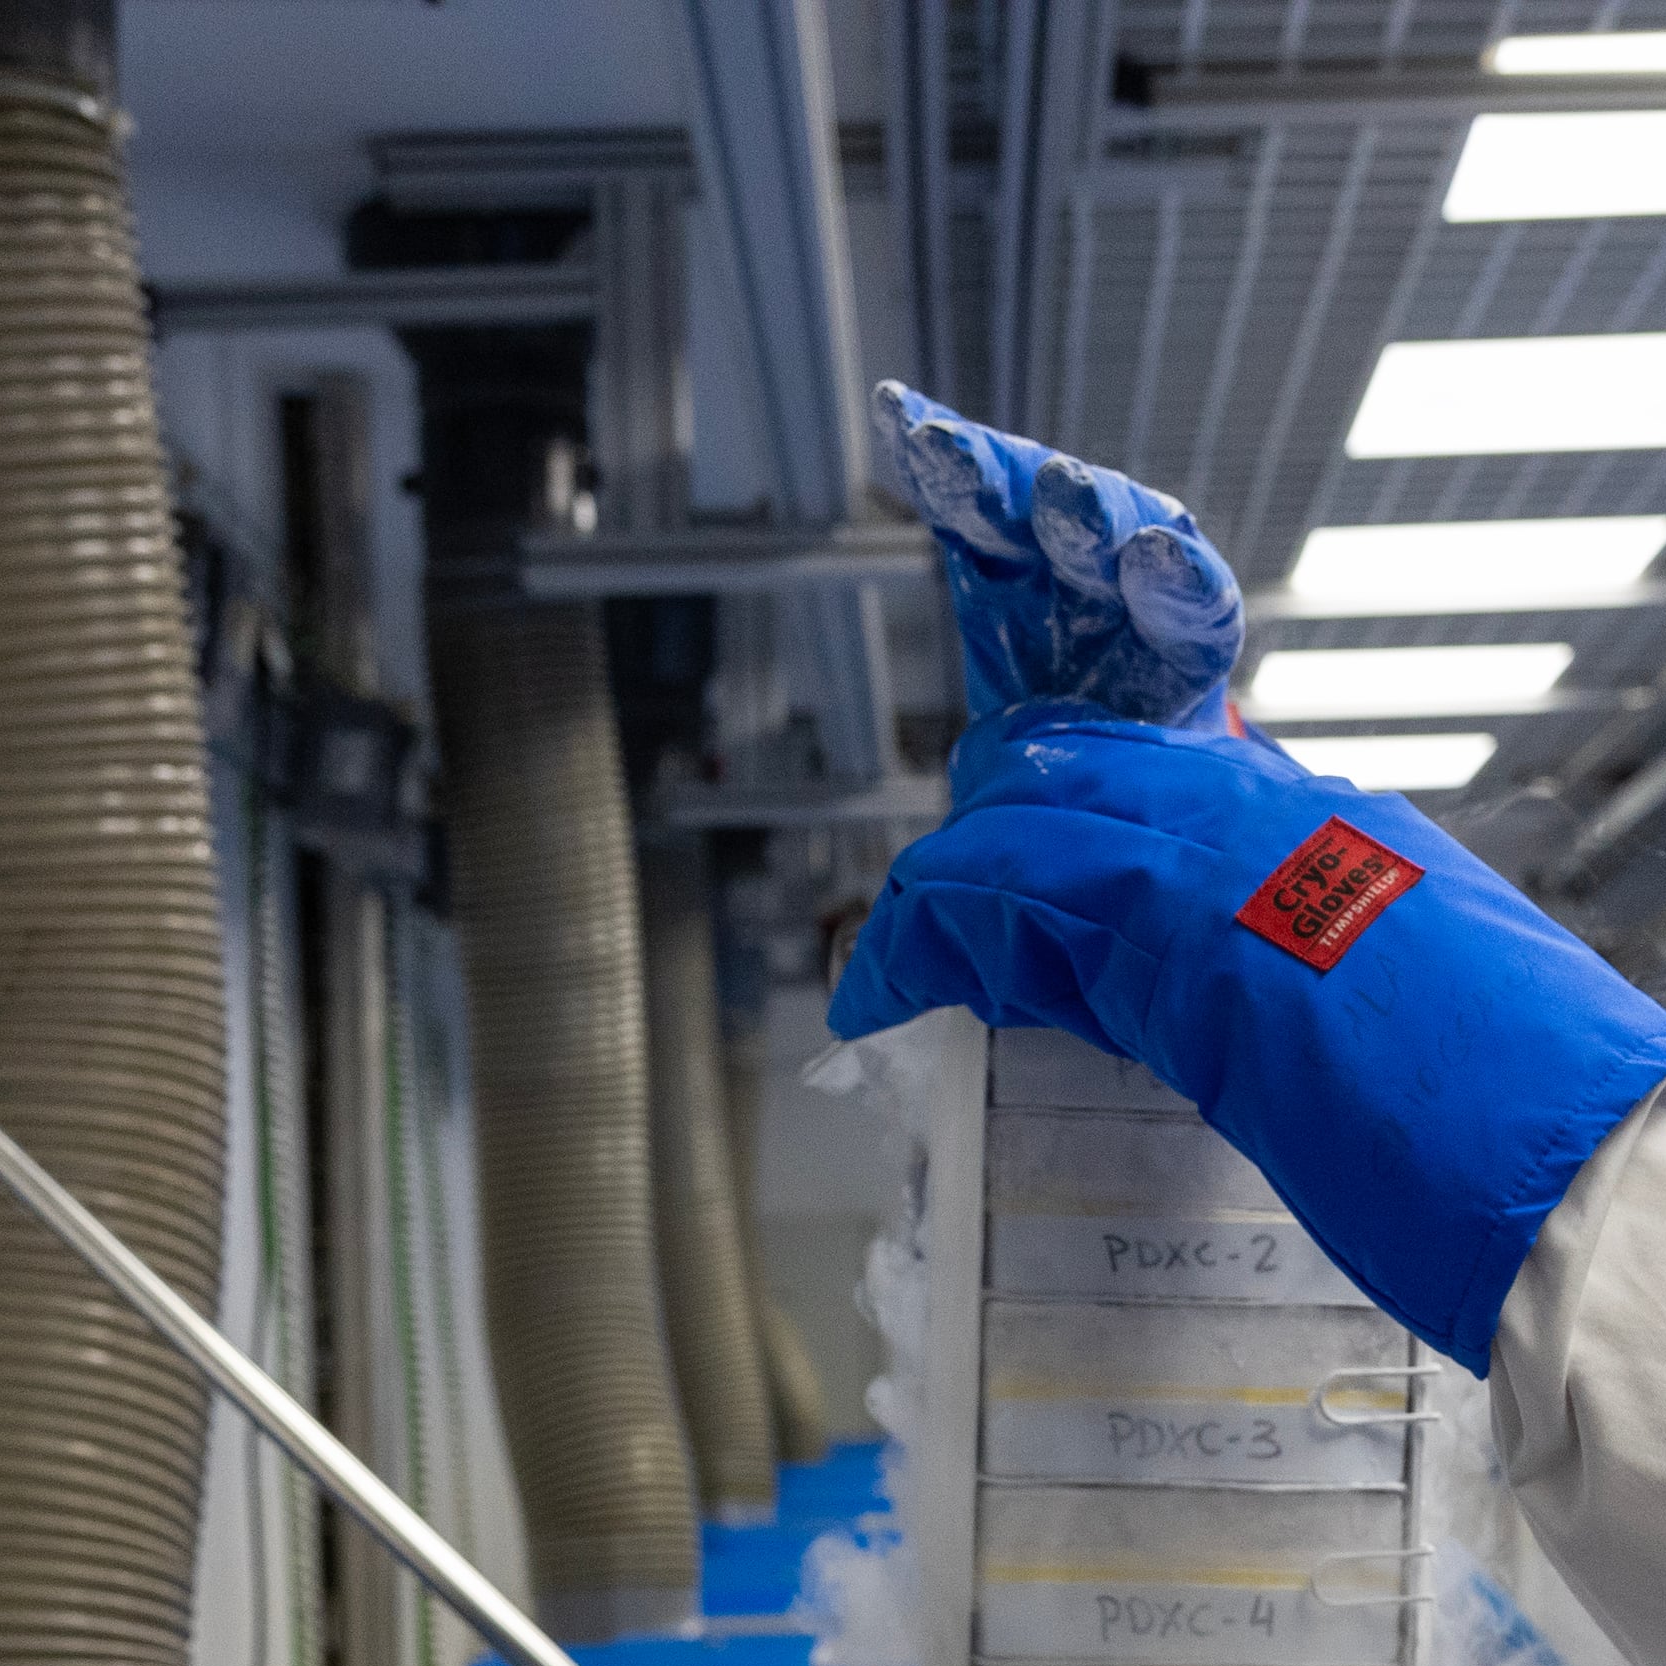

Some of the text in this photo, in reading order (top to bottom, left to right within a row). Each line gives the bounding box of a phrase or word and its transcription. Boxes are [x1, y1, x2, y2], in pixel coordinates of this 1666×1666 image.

[1103, 1233, 1278, 1273] PDXC-2
[1107, 1411, 1283, 1461] PDXC-3
[1096, 1594, 1275, 1643] PDXC-4
